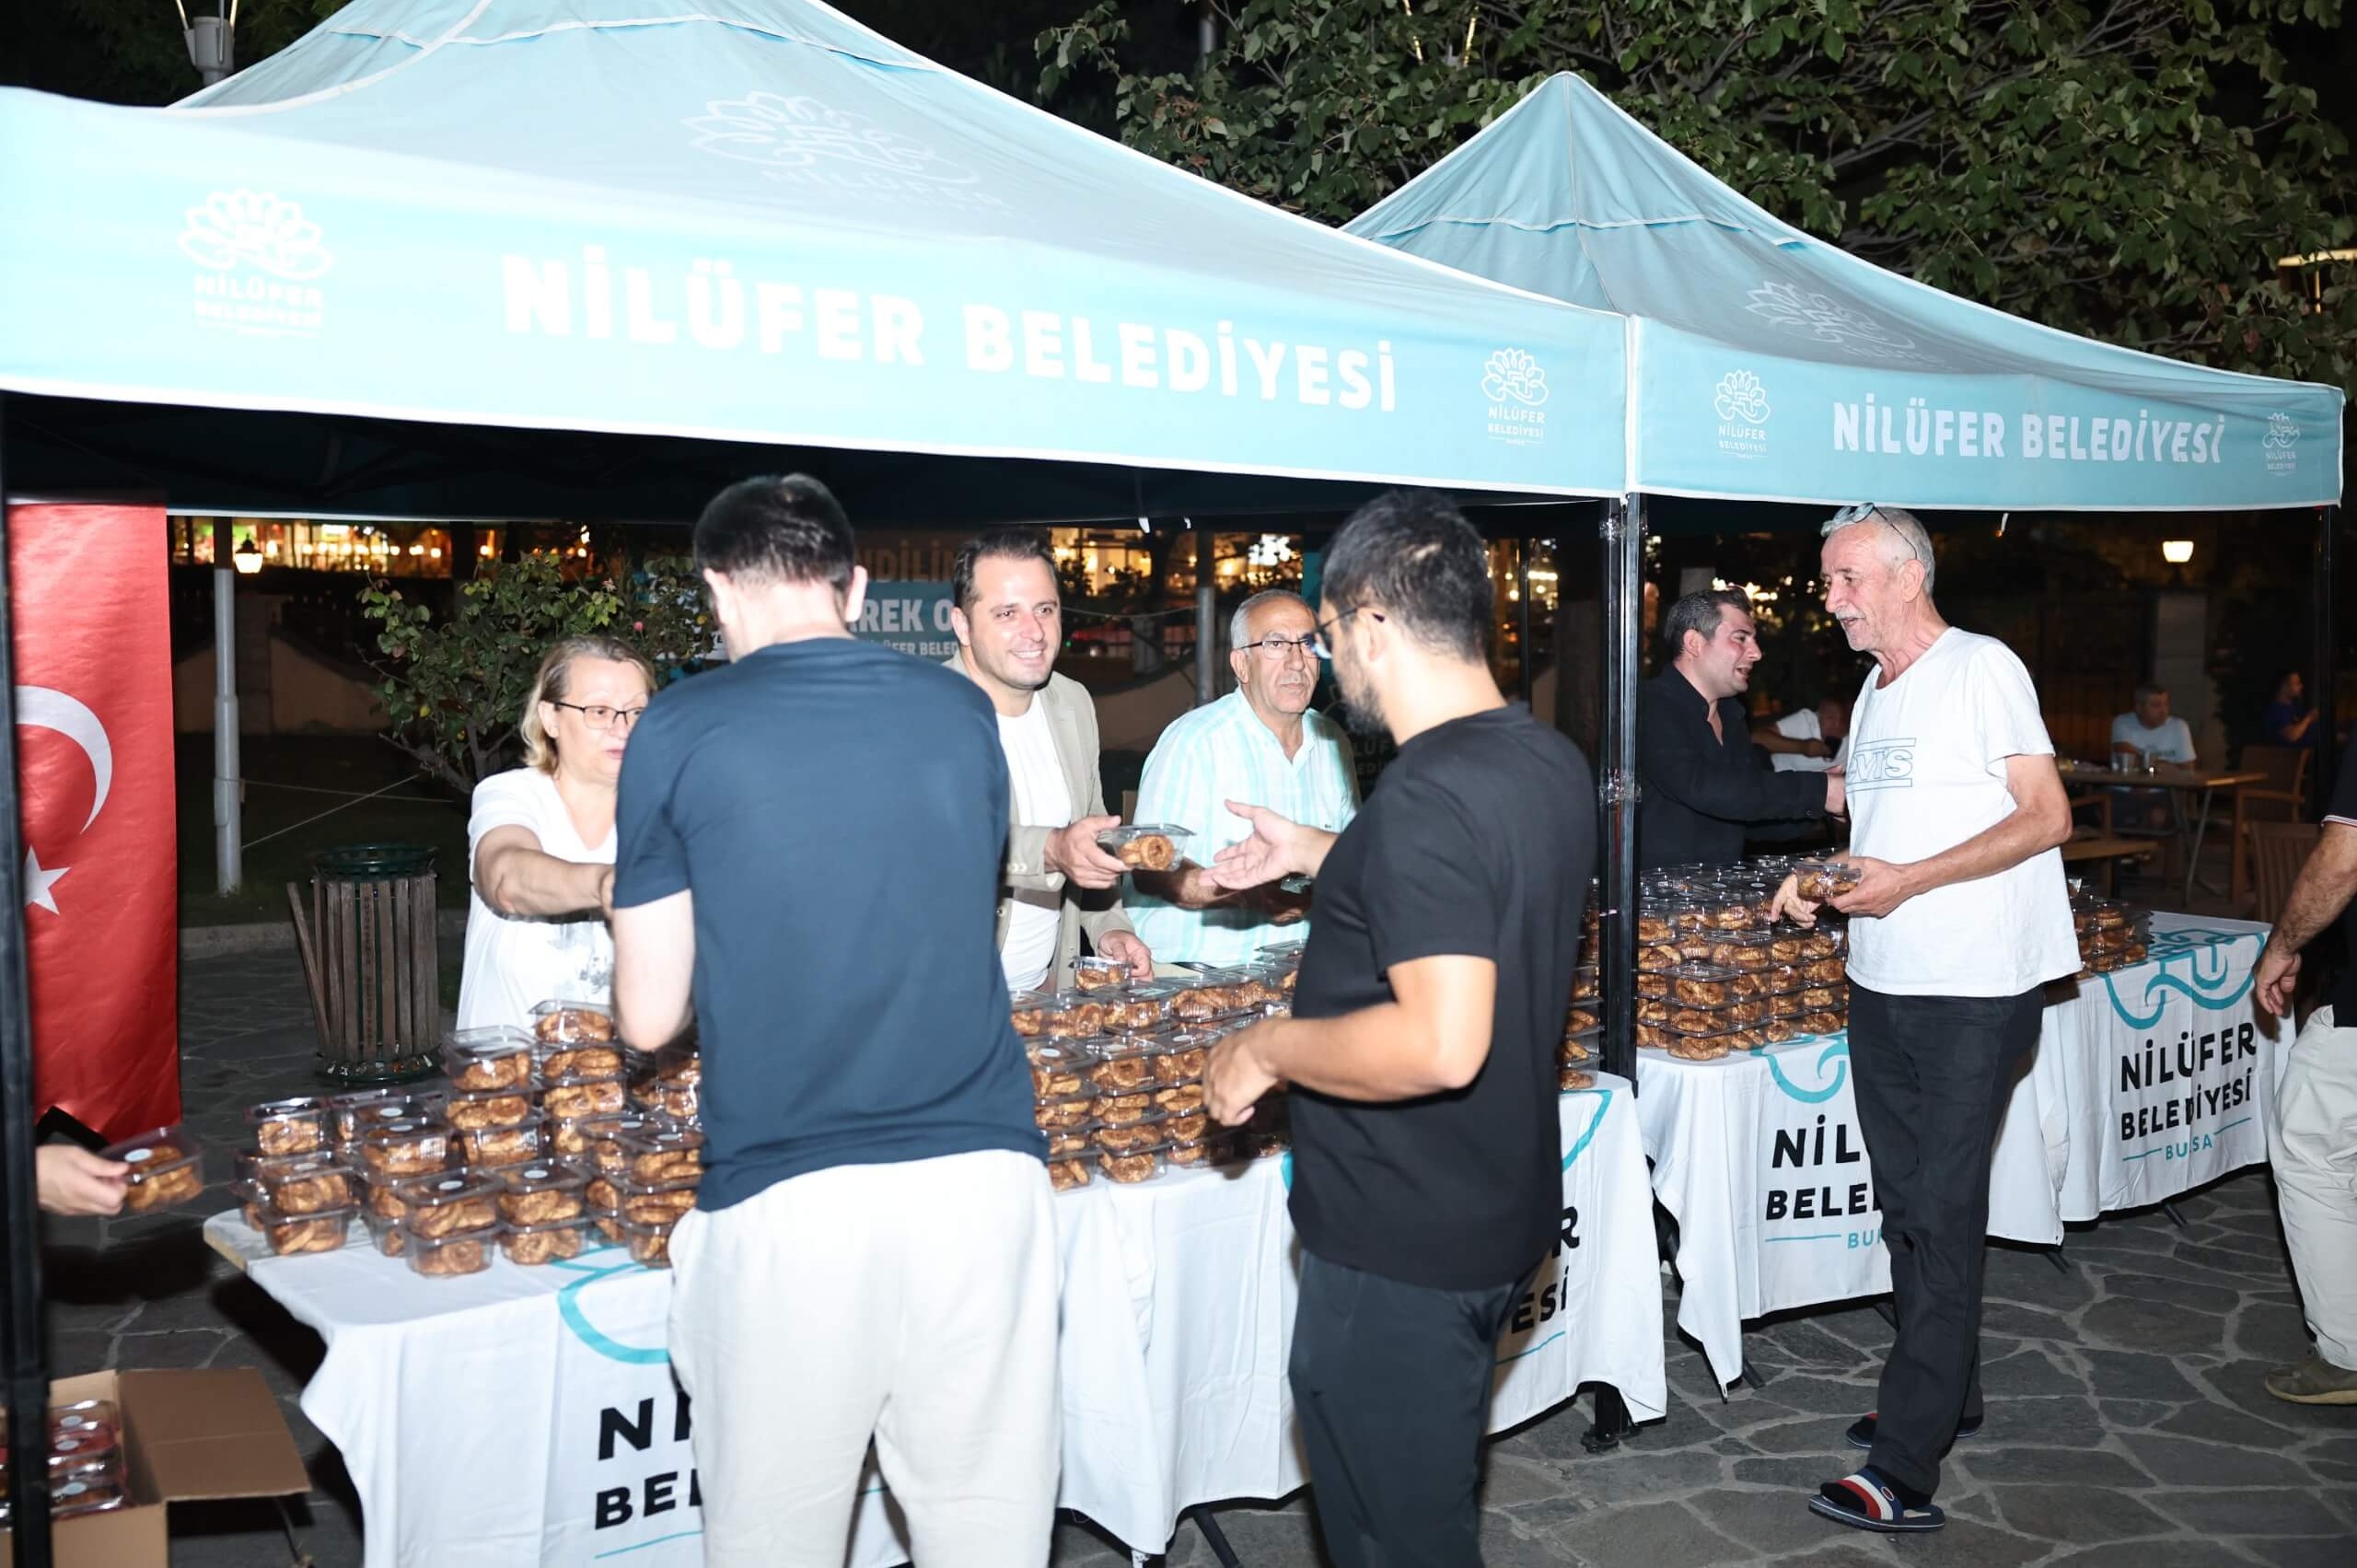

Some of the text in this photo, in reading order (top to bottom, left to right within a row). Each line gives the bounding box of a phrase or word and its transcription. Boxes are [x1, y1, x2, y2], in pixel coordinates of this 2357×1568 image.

[503, 243, 1396, 412] NİLÜFER BELEDİYESİ
[1488, 404, 1546, 424] NİLÜFER
[1488, 423, 1545, 438] BELEDİYESİ
[1718, 424, 1767, 440] NİLÜFER
[1833, 392, 2226, 464] NİLÜFER BELEDİYESİ
[847, 598, 923, 632] REK
[2121, 1022, 2257, 1092] NİLÜFER
[2121, 1067, 2252, 1132] BELEDİYESİ
[1772, 1114, 1861, 1168] NİL
[2165, 1133, 2212, 1160] BUSA
